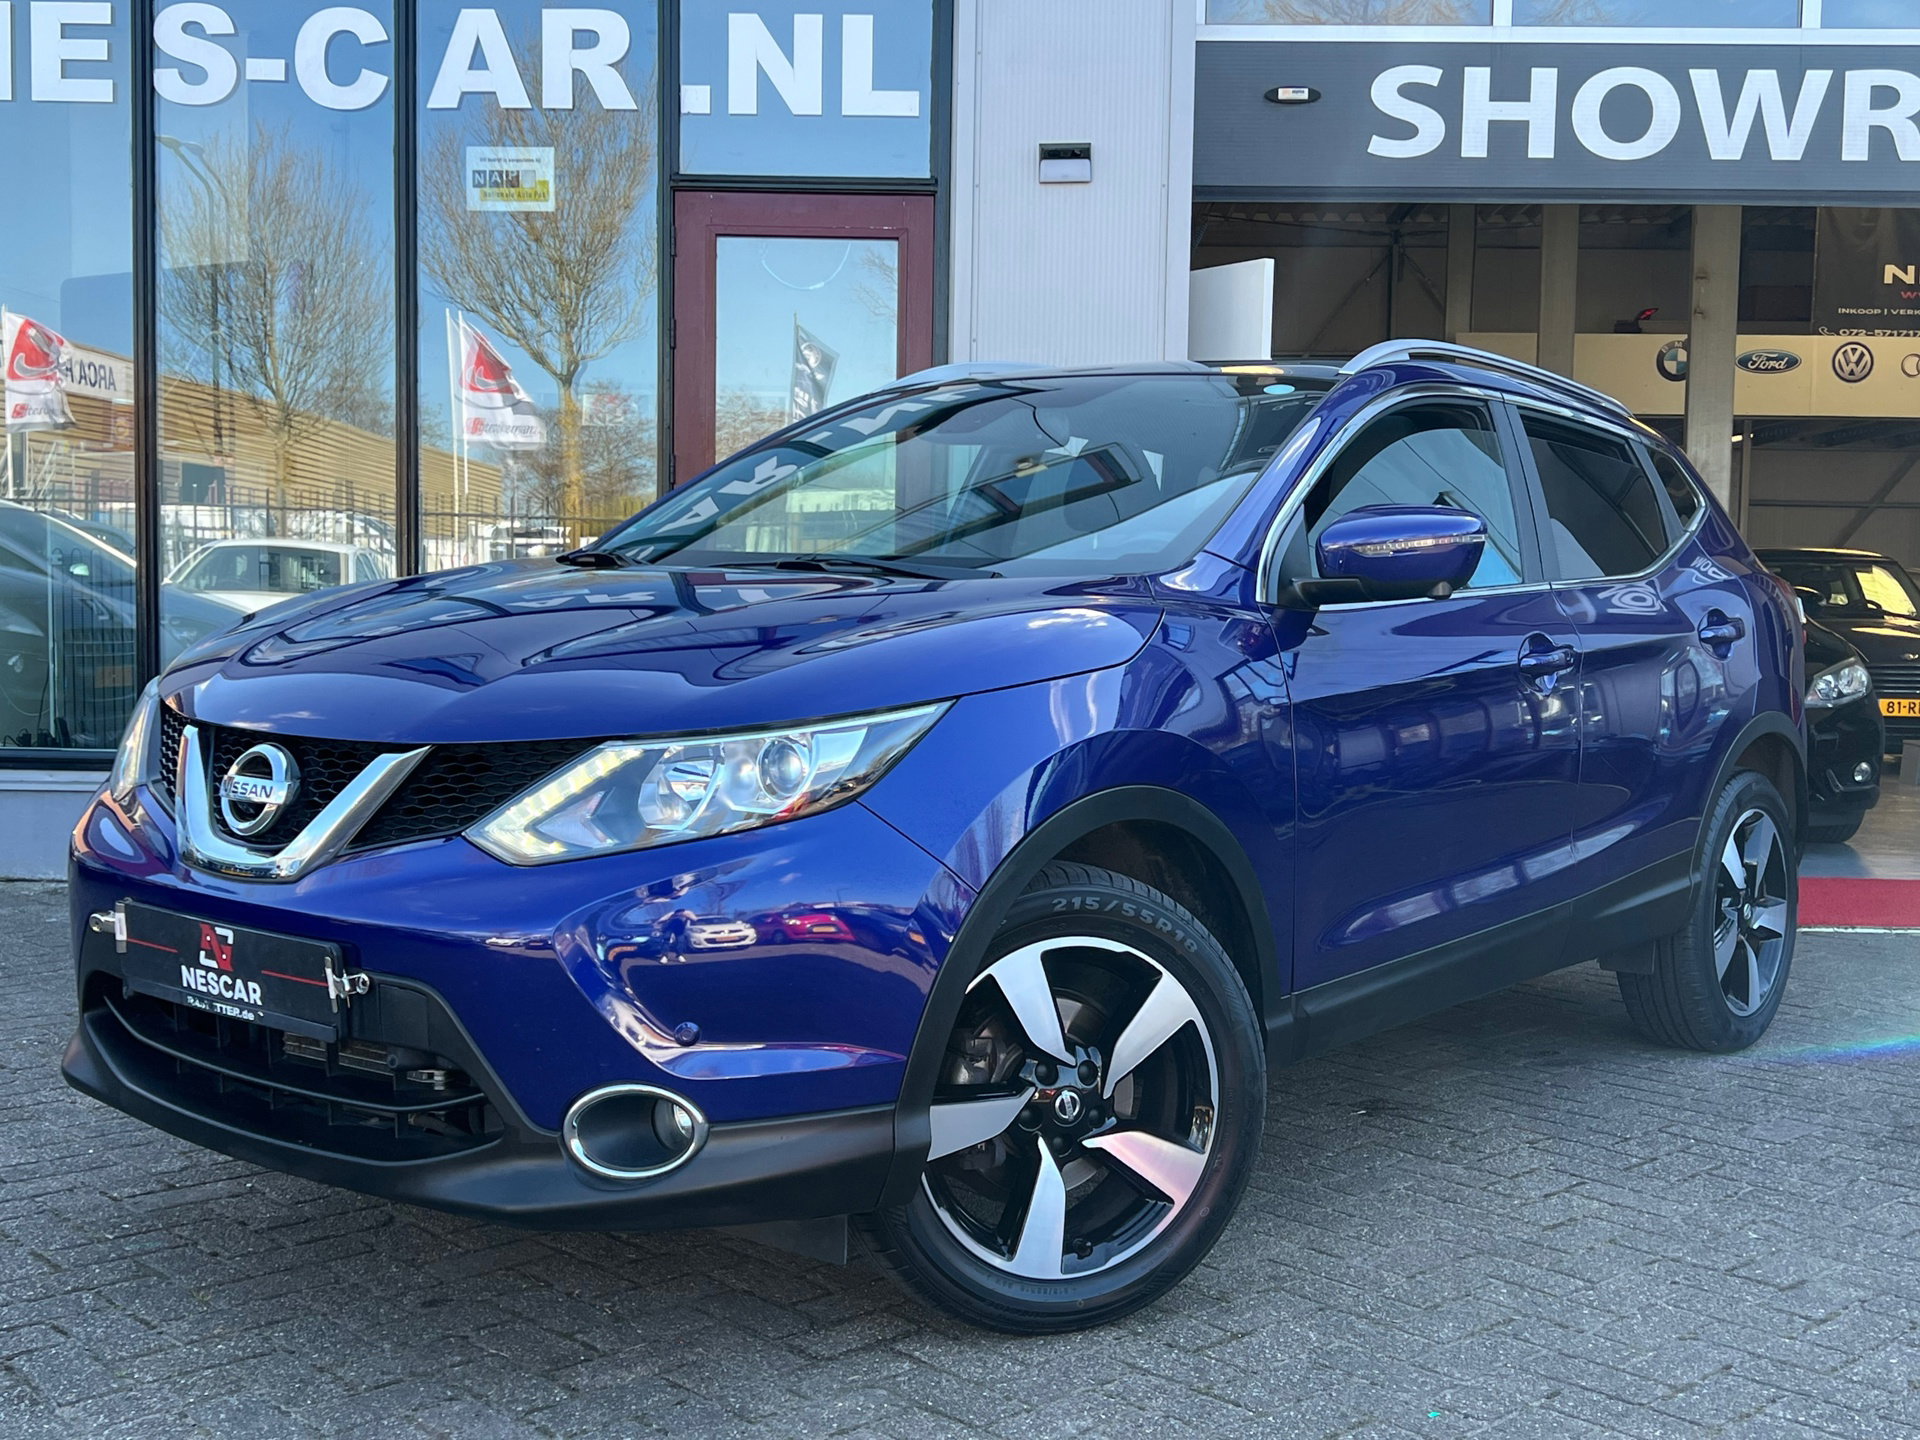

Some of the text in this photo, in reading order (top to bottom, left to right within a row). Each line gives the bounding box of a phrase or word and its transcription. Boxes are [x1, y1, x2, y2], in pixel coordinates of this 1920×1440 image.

[1883, 263, 1920, 285] N
[1838, 307, 1881, 316] INKOOP
[1748, 352, 1788, 371] Ford
[1887, 701, 1920, 714] 81-R
[1051, 897, 1199, 954] 215/55R18
[180, 964, 263, 1006] NESCAR
